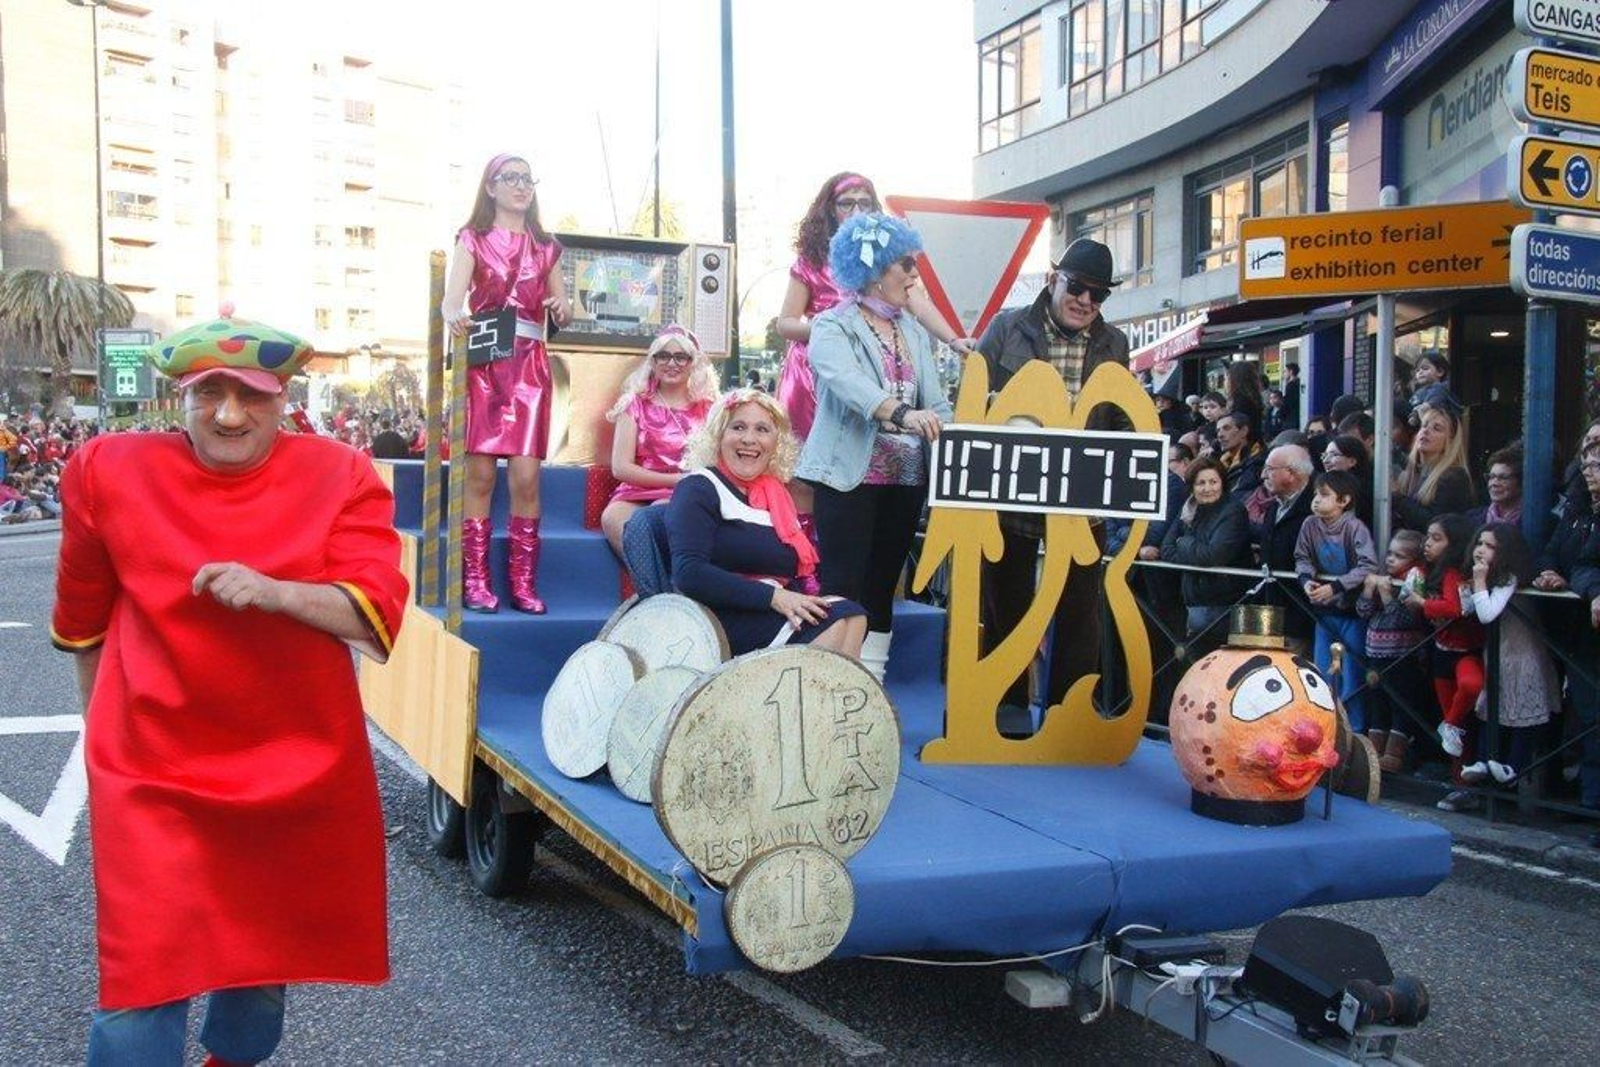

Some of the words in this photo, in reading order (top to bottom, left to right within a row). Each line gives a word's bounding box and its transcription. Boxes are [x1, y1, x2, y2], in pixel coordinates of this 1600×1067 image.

[1531, 64, 1593, 87] mercado
[1531, 83, 1571, 113] Teis
[1289, 229, 1373, 250] recinto
[1380, 221, 1444, 244] ferial
[1529, 237, 1571, 261] todas
[1290, 255, 1396, 281] exhibition
[1407, 253, 1484, 276] center
[941, 439, 1159, 512] 100175
[763, 665, 818, 811] 1
[786, 858, 811, 930] 1
